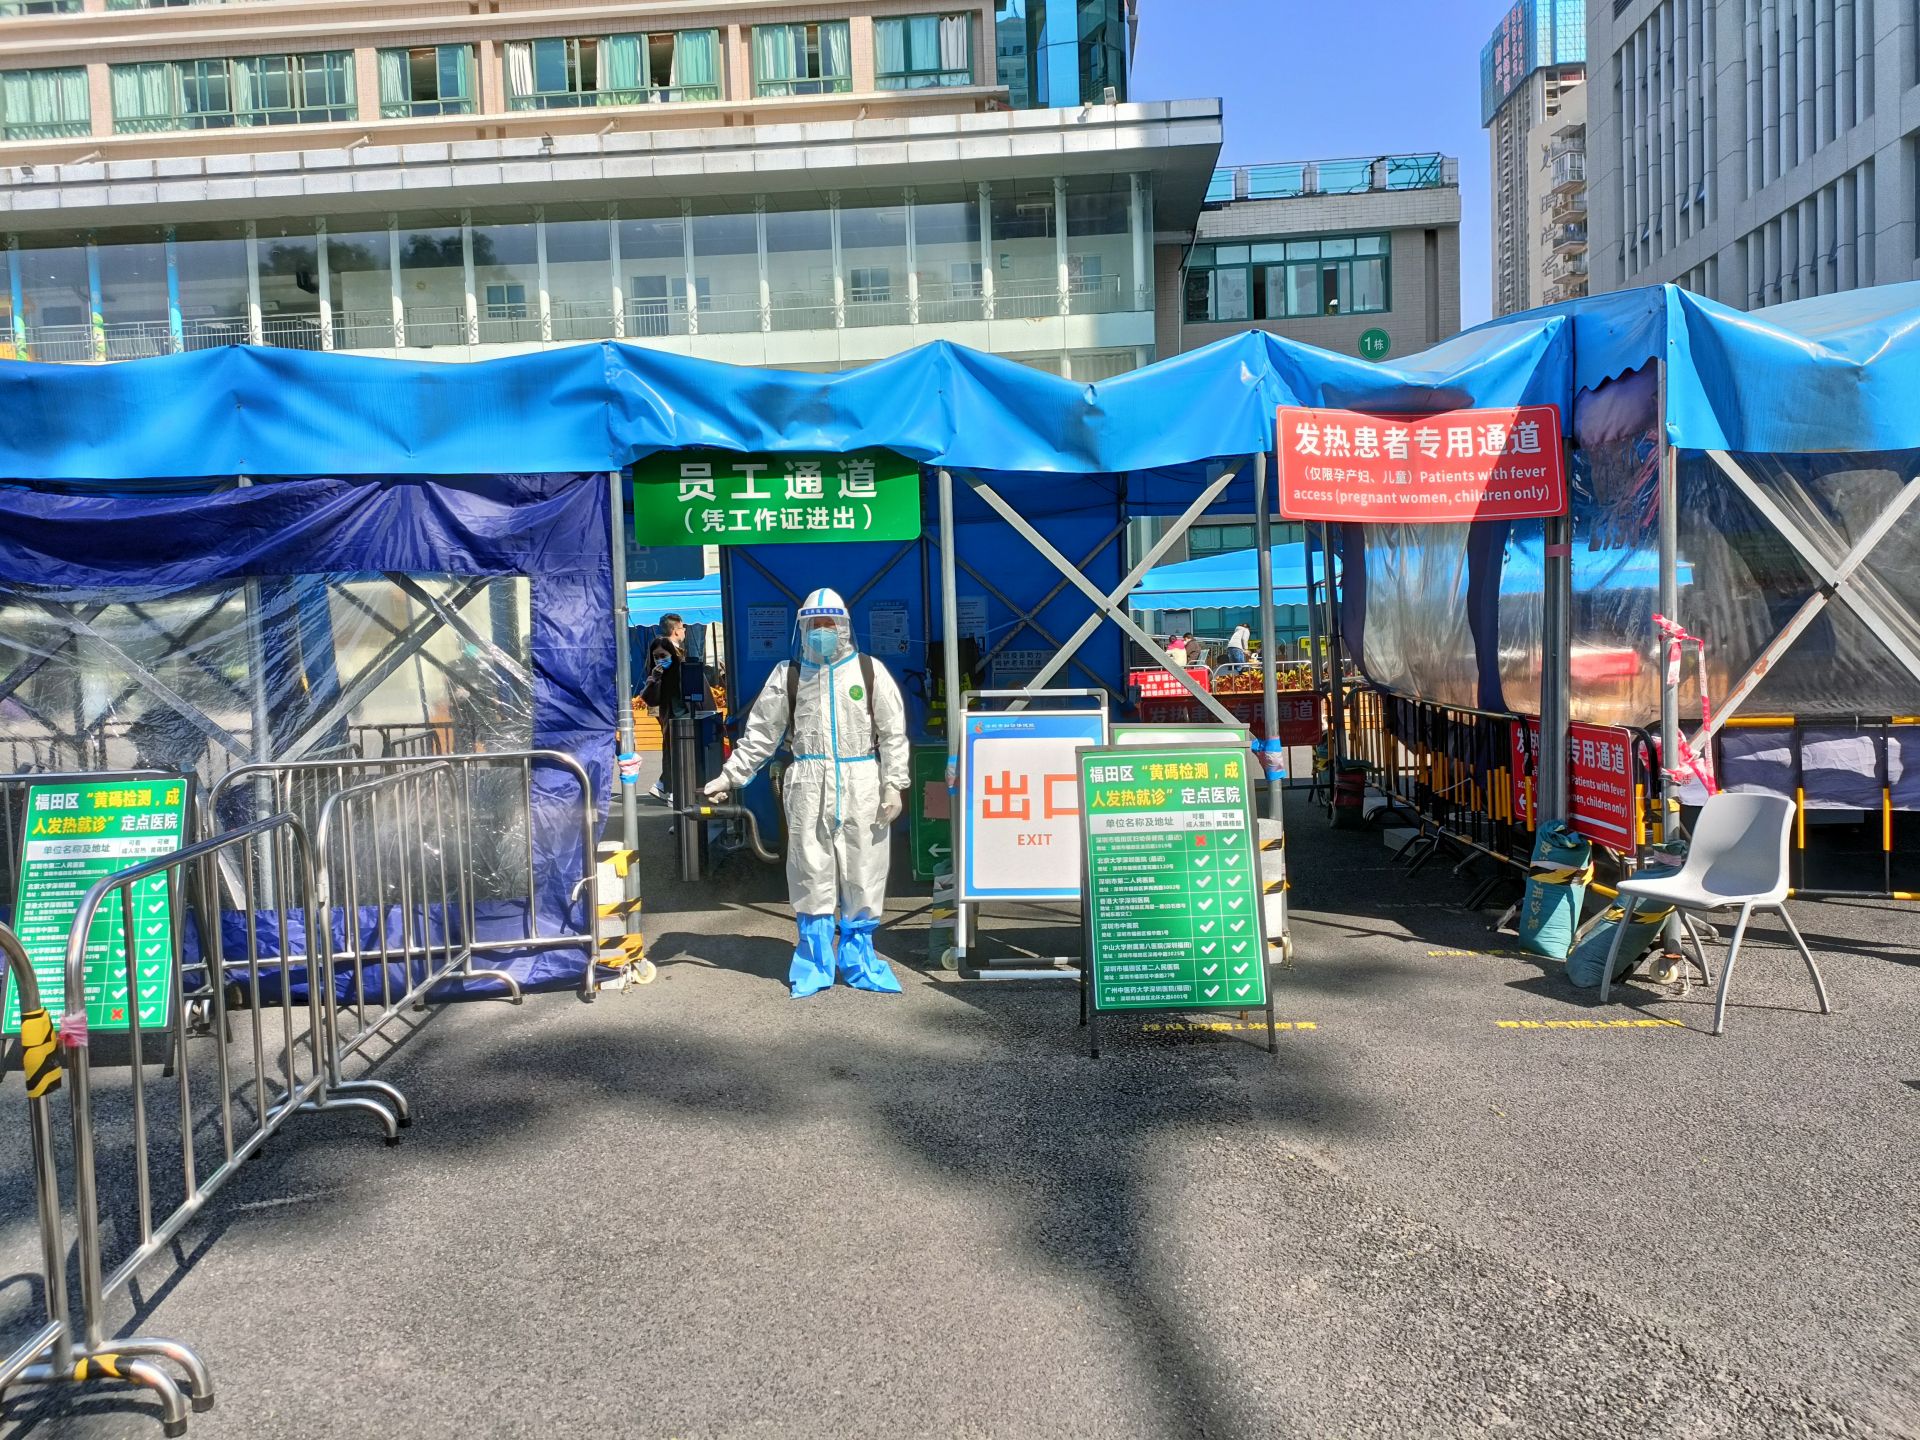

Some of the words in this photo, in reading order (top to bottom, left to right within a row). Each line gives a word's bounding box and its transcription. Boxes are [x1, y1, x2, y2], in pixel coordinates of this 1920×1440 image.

[1364, 337, 1384, 351] 1栋
[1295, 421, 1543, 461] 发热患者专用通道
[677, 459, 878, 503] 员工通道
[1420, 470, 1475, 483] Patients
[1478, 468, 1507, 481] with
[1510, 466, 1547, 480] fever
[1293, 488, 1333, 501] access
[1335, 489, 1397, 505] (pregnant
[1400, 492, 1452, 504] women,
[1455, 487, 1511, 502] children
[1514, 485, 1550, 501] only)
[684, 504, 874, 534] （凭工作证进出）
[1090, 765, 1134, 783] 福田区
[982, 770, 1079, 820] 出口
[1181, 786, 1241, 805] 定点医院
[1597, 781, 1611, 794] with
[1611, 782, 1626, 798] fever
[35, 793, 79, 811] 福田区
[1587, 797, 1611, 811] children
[1611, 804, 1627, 818] only)
[121, 813, 178, 832] 定点医院
[1105, 817, 1174, 828] 单位名称及地址
[44, 843, 110, 855] 单位名称及地址
[1017, 834, 1053, 846] EXIT
